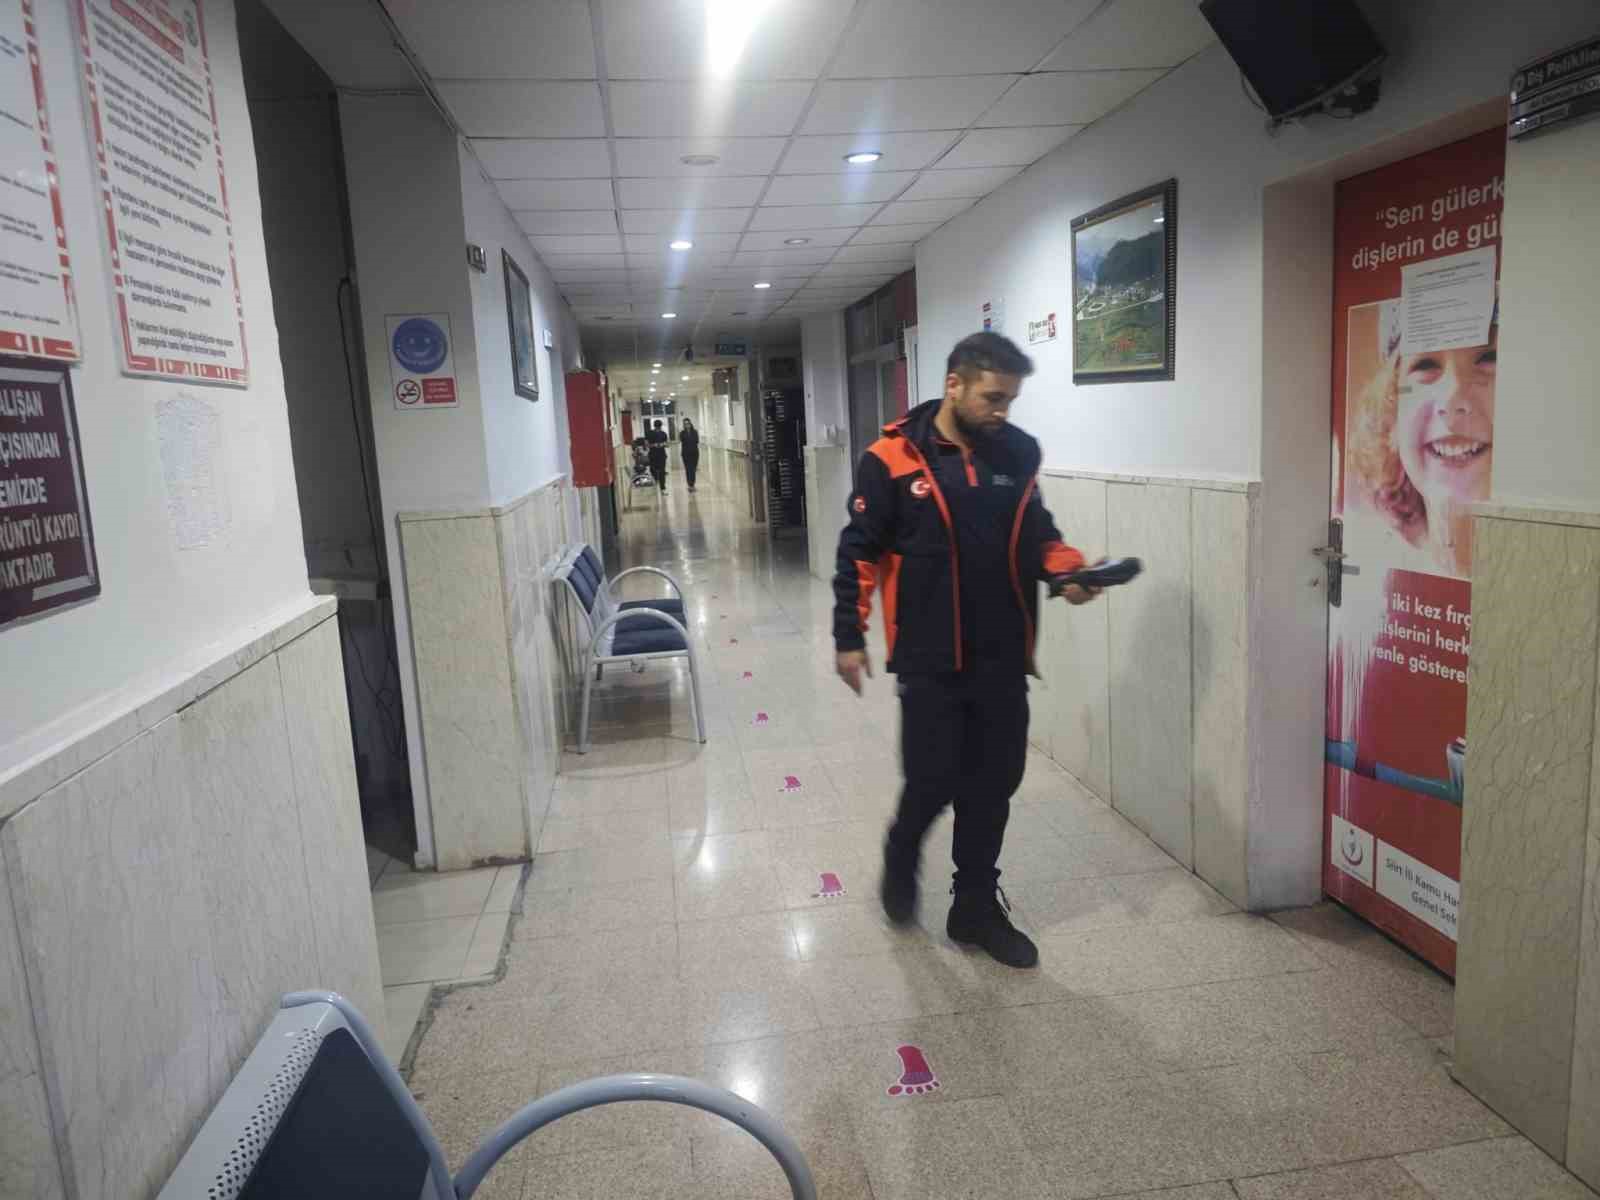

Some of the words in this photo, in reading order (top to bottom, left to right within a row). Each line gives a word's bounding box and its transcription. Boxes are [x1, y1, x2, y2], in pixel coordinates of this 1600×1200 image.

[1352, 236, 1425, 271] dişlerin
[1432, 227, 1459, 251] de
[1392, 593, 1410, 612] iki
[1414, 597, 1441, 619] kez
[1435, 630, 1471, 655] herk
